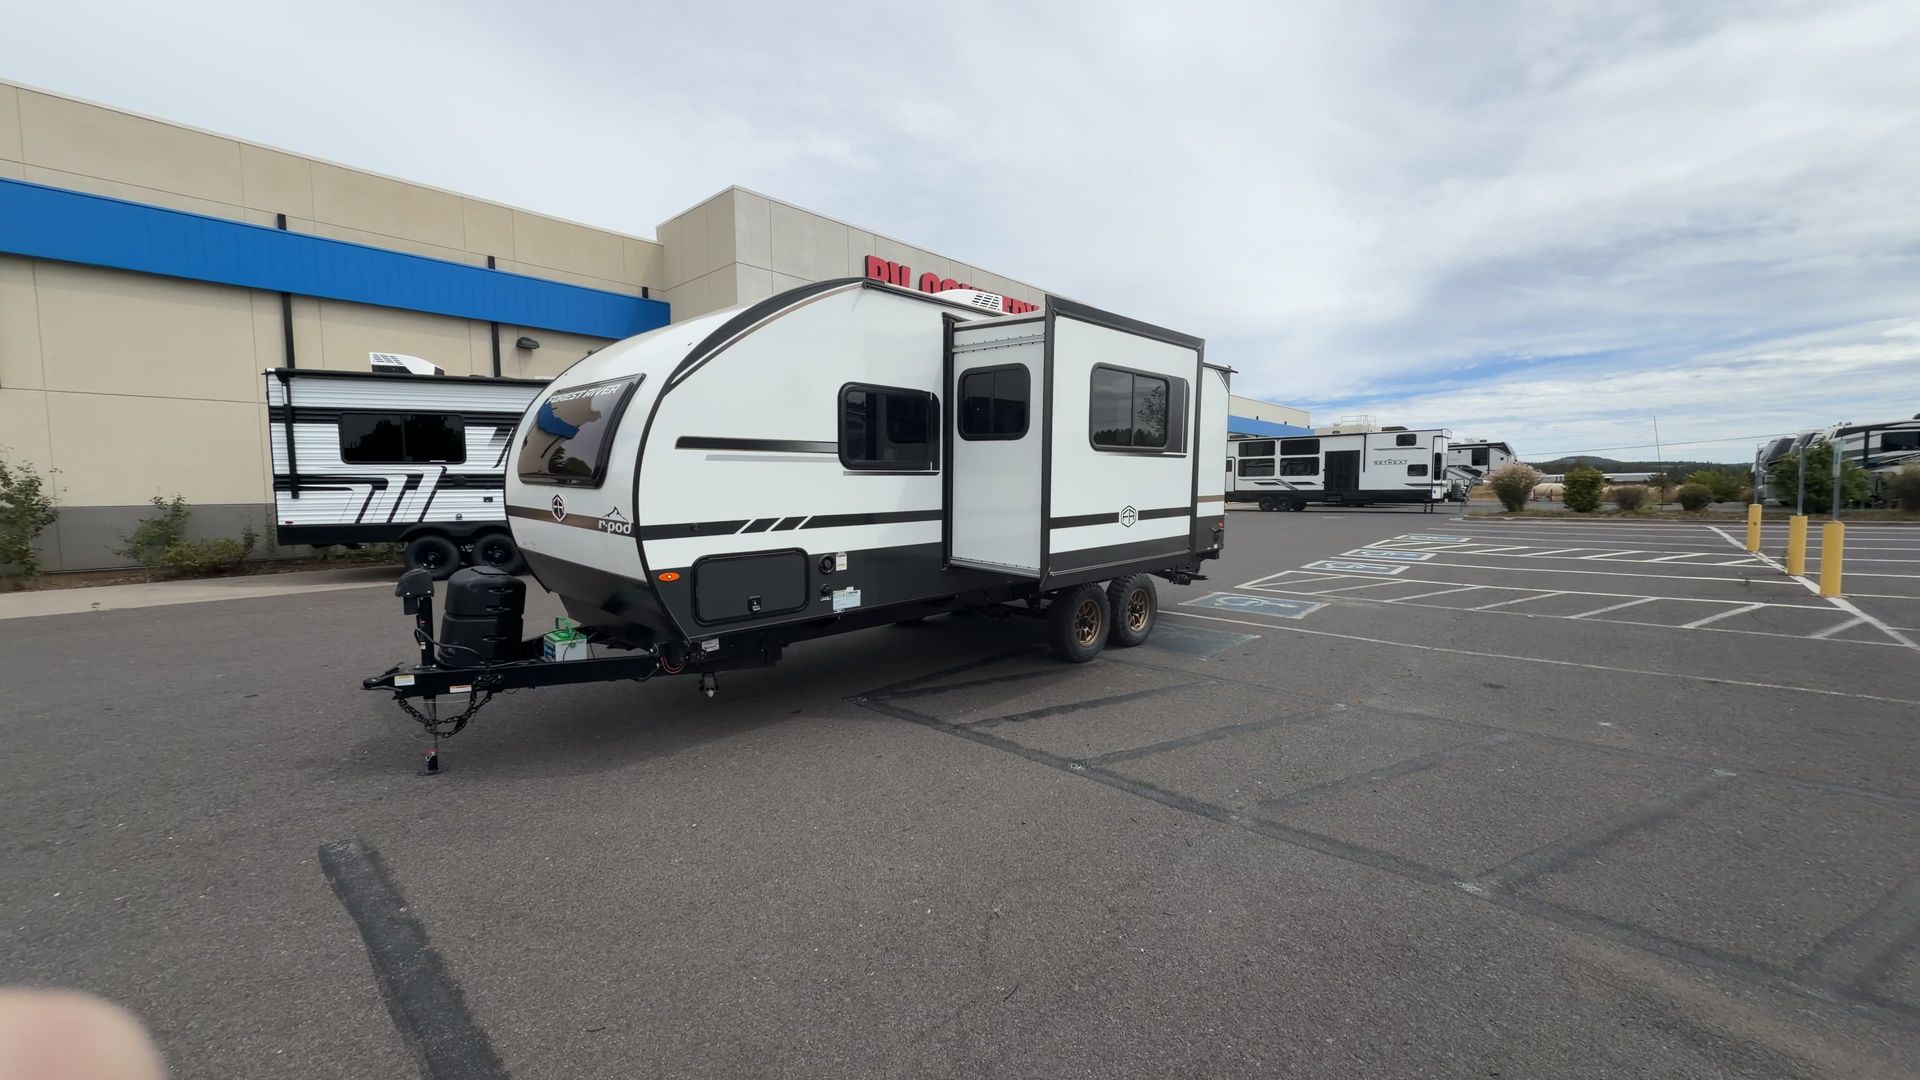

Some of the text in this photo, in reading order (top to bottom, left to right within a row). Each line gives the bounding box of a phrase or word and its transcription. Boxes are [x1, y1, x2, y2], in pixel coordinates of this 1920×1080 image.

[865, 255, 911, 288] RV
[546, 383, 622, 405] FOREST RIVER
